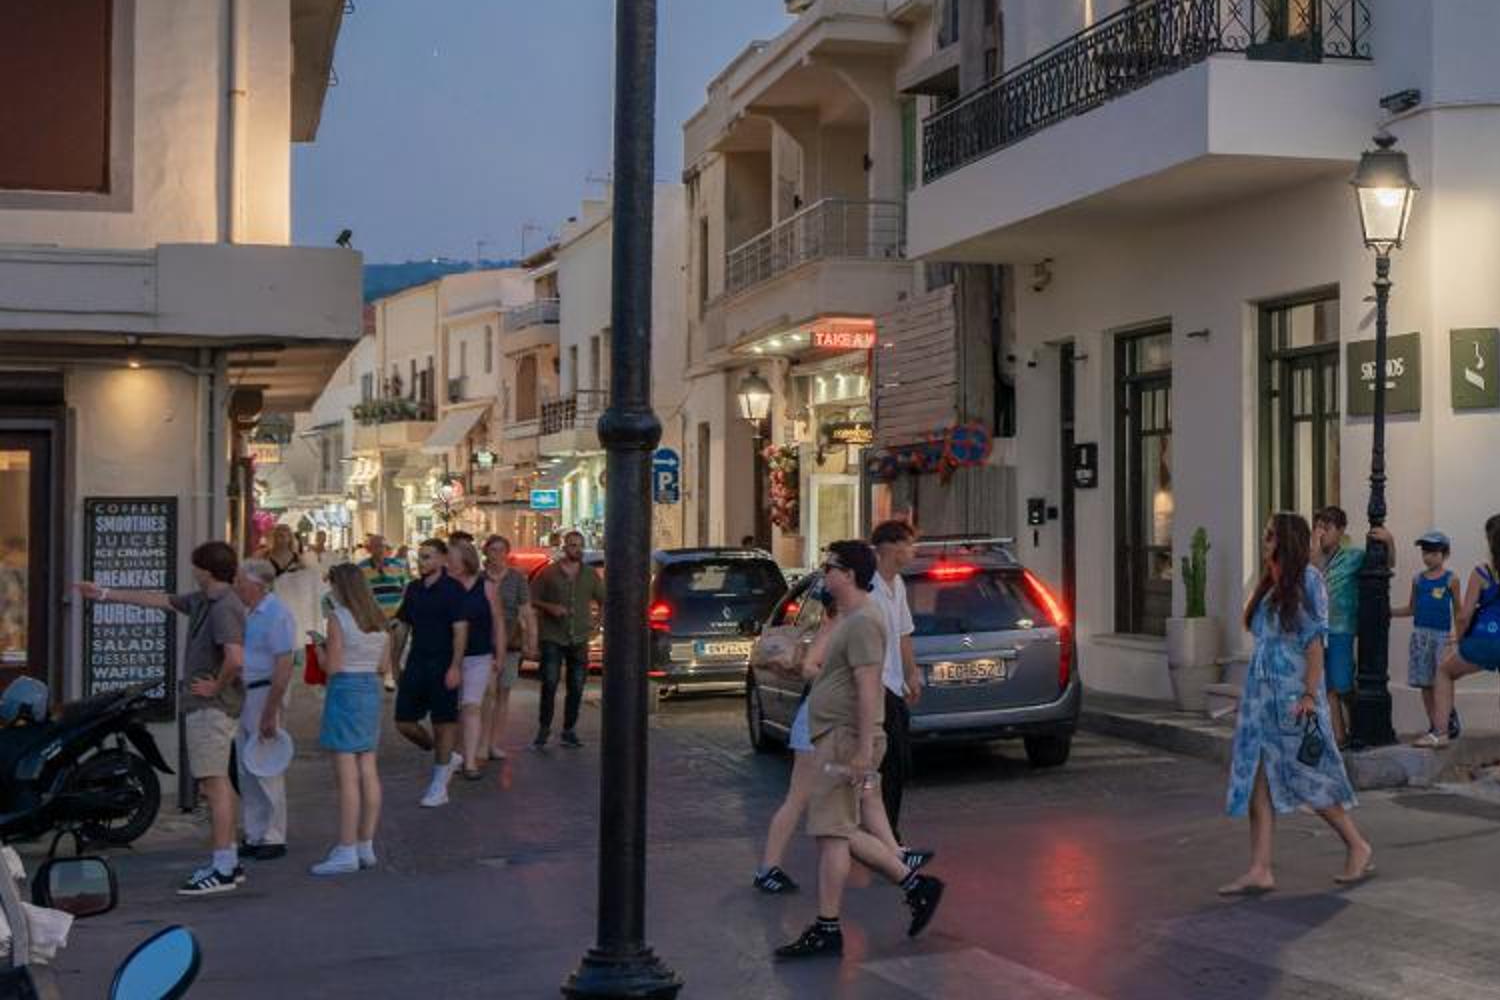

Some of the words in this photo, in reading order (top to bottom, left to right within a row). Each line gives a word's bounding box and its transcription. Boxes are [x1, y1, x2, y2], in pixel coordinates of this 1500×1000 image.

[659, 472, 673, 490] P
[96, 503, 168, 514] COFFEES
[96, 515, 167, 532] SMOOTHIES
[96, 535, 167, 547] JUICES
[94, 569, 166, 587] BREAKFAST
[93, 603, 167, 624] BURGERS
[93, 627, 166, 637] SNACKS
[93, 639, 166, 651] SALADS
[92, 653, 165, 665] DESSERTS
[92, 666, 165, 679] WAFFLES
